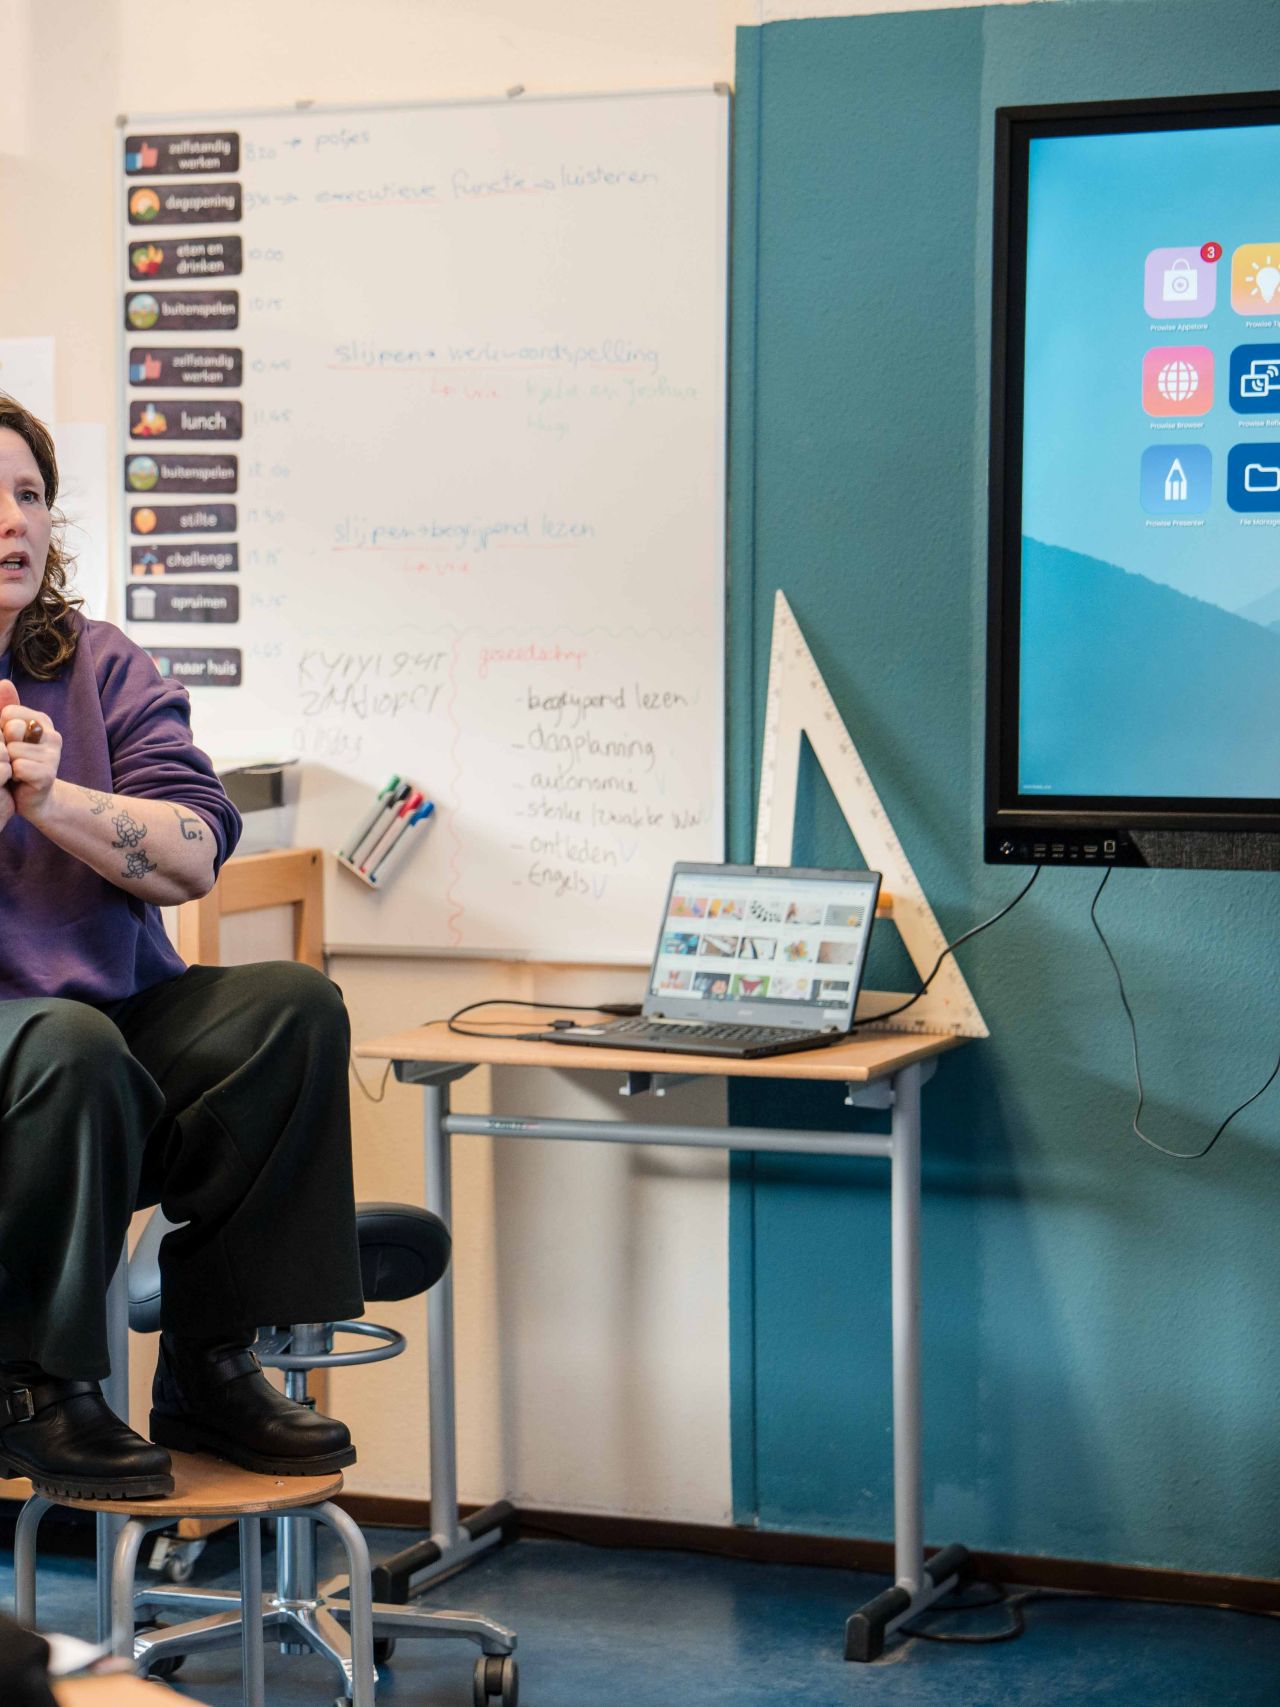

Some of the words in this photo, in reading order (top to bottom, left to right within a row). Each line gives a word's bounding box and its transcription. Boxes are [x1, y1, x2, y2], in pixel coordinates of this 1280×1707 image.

[177, 155, 221, 170] werken
[165, 193, 236, 213] dagopening
[176, 243, 206, 257] eten
[206, 243, 224, 256] en
[1207, 246, 1215, 258] 3
[176, 259, 225, 274] drinken
[161, 300, 236, 318] buitenspelen
[182, 369, 224, 383] werken
[180, 410, 228, 431] lunch
[161, 464, 235, 482] buitenspelen
[179, 511, 218, 528] stilte
[166, 551, 234, 569] challenge
[170, 594, 227, 611] opruimen
[172, 661, 206, 675] naar
[206, 658, 237, 676] huis
[635, 680, 689, 710] lezen
[527, 859, 590, 898] Engels
